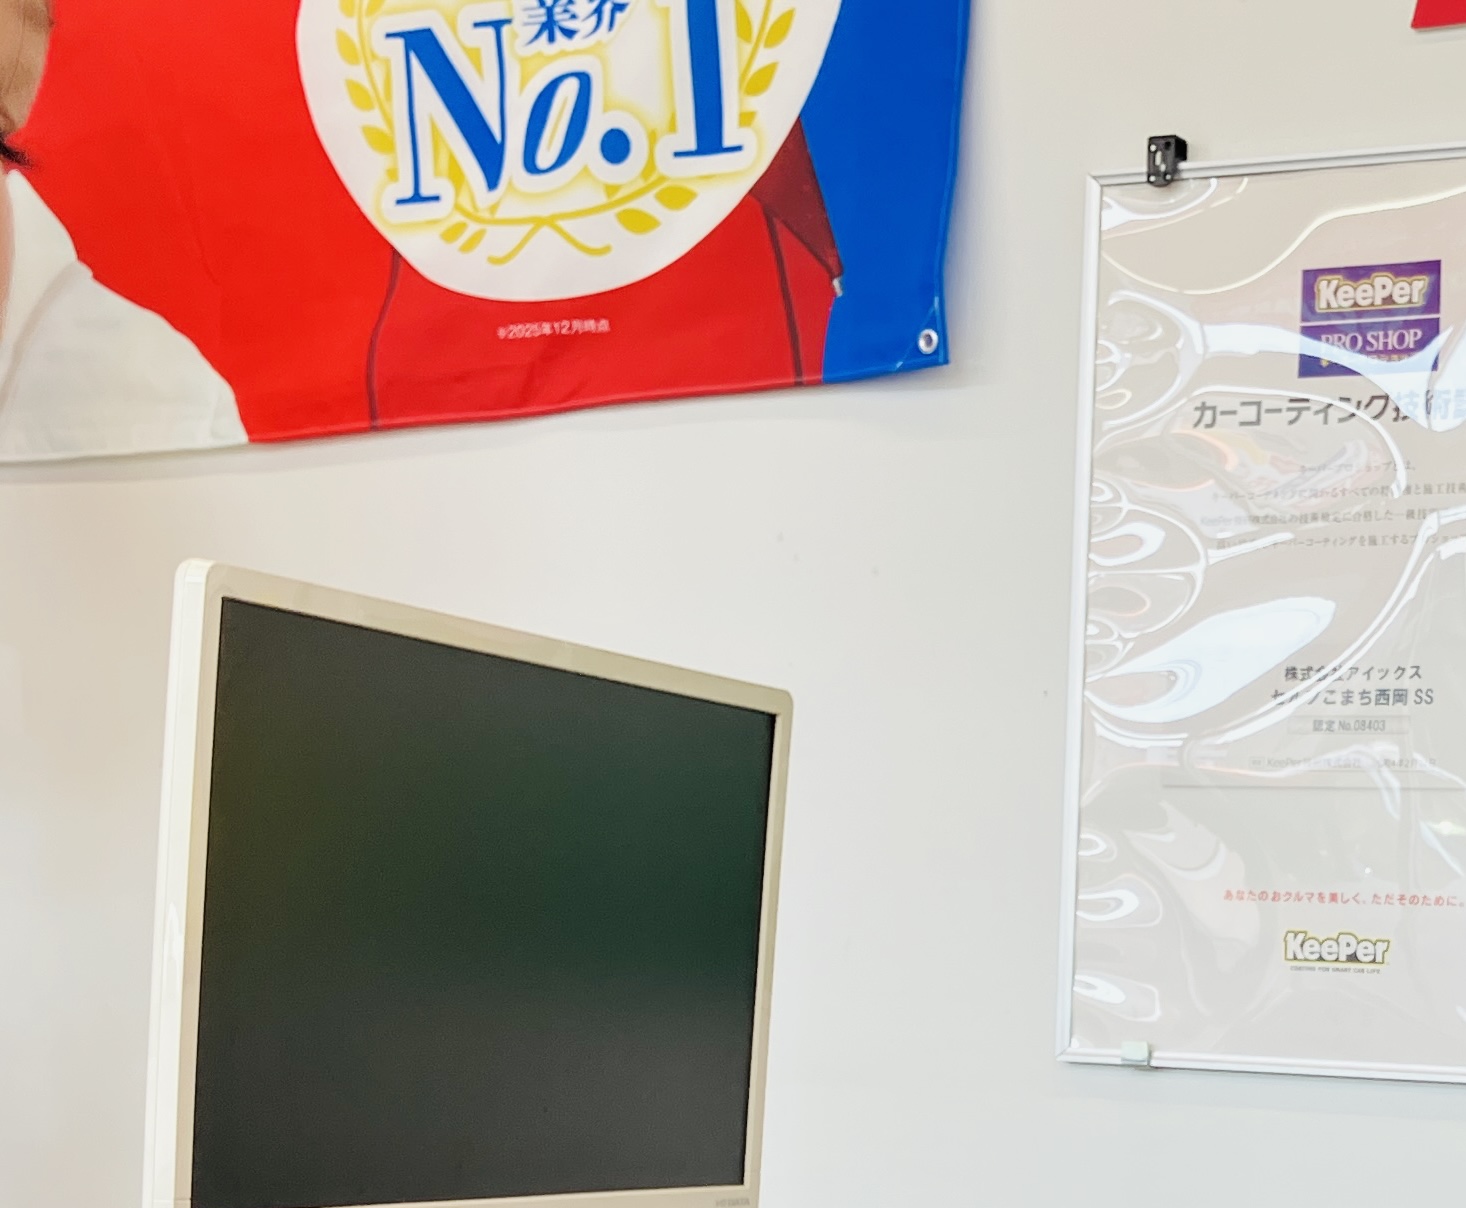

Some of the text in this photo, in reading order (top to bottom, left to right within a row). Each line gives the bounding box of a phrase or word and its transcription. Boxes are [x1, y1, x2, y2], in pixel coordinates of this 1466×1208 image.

[385, 0, 744, 205] No.1
[1314, 272, 1429, 313] KeePer
[1365, 328, 1423, 351] SHOP
[1413, 688, 1434, 705] SS
[1284, 930, 1390, 964] KeePer
